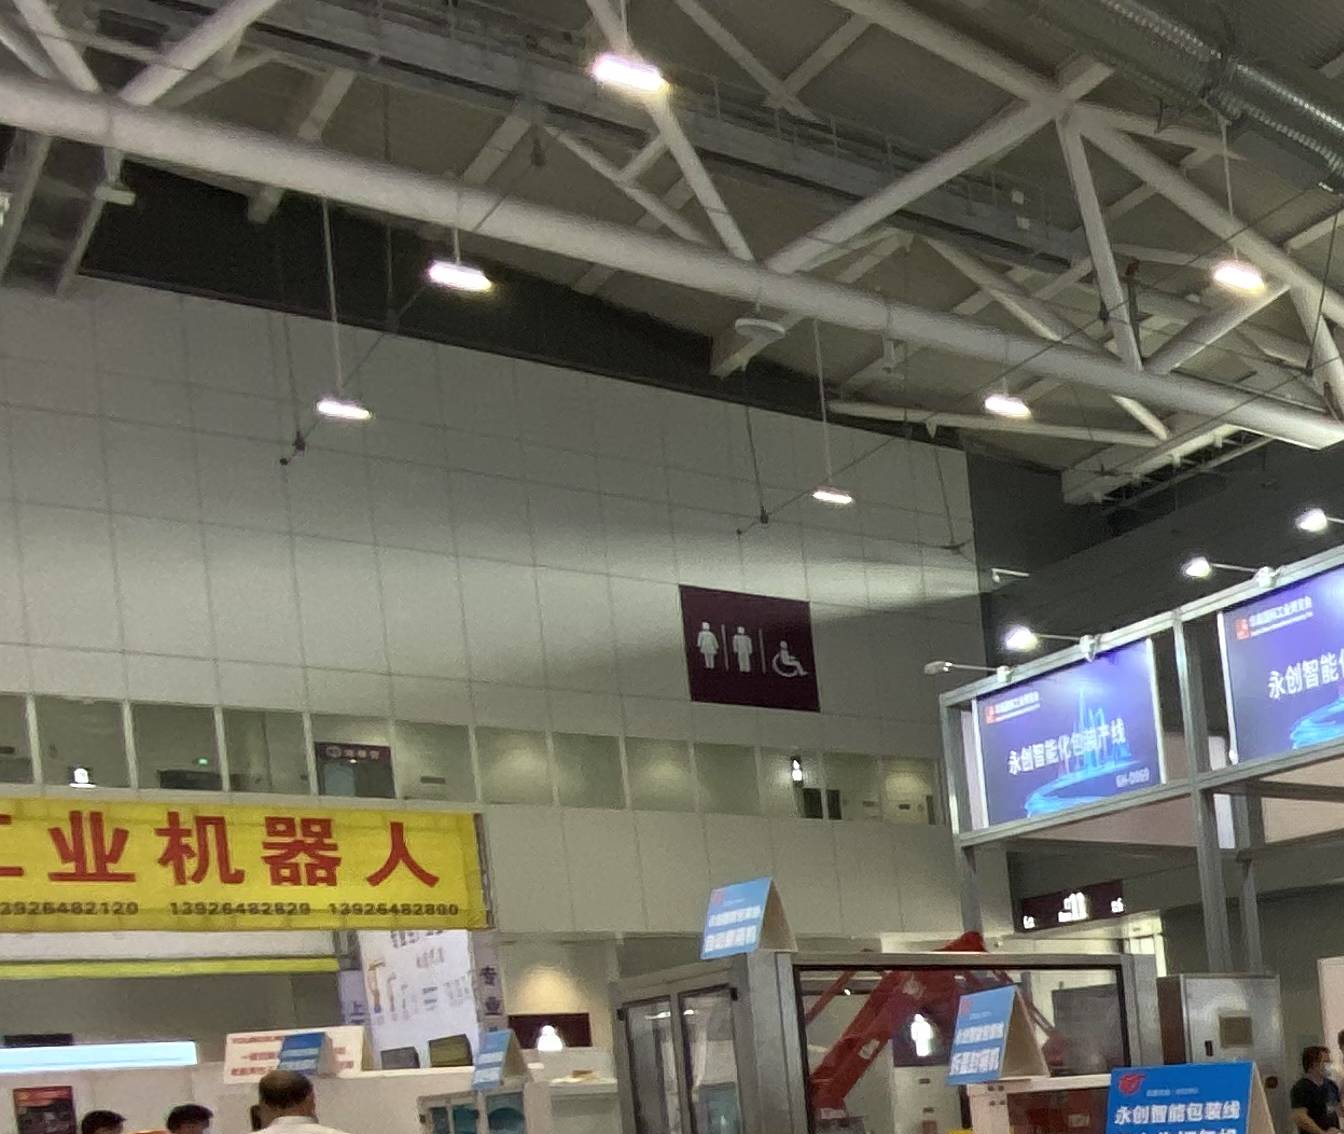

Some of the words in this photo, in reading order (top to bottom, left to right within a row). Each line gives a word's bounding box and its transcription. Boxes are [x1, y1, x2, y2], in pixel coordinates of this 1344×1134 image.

[0, 810, 440, 887] 业机器人
[1114, 1099, 1241, 1126] 永创智能包装线
